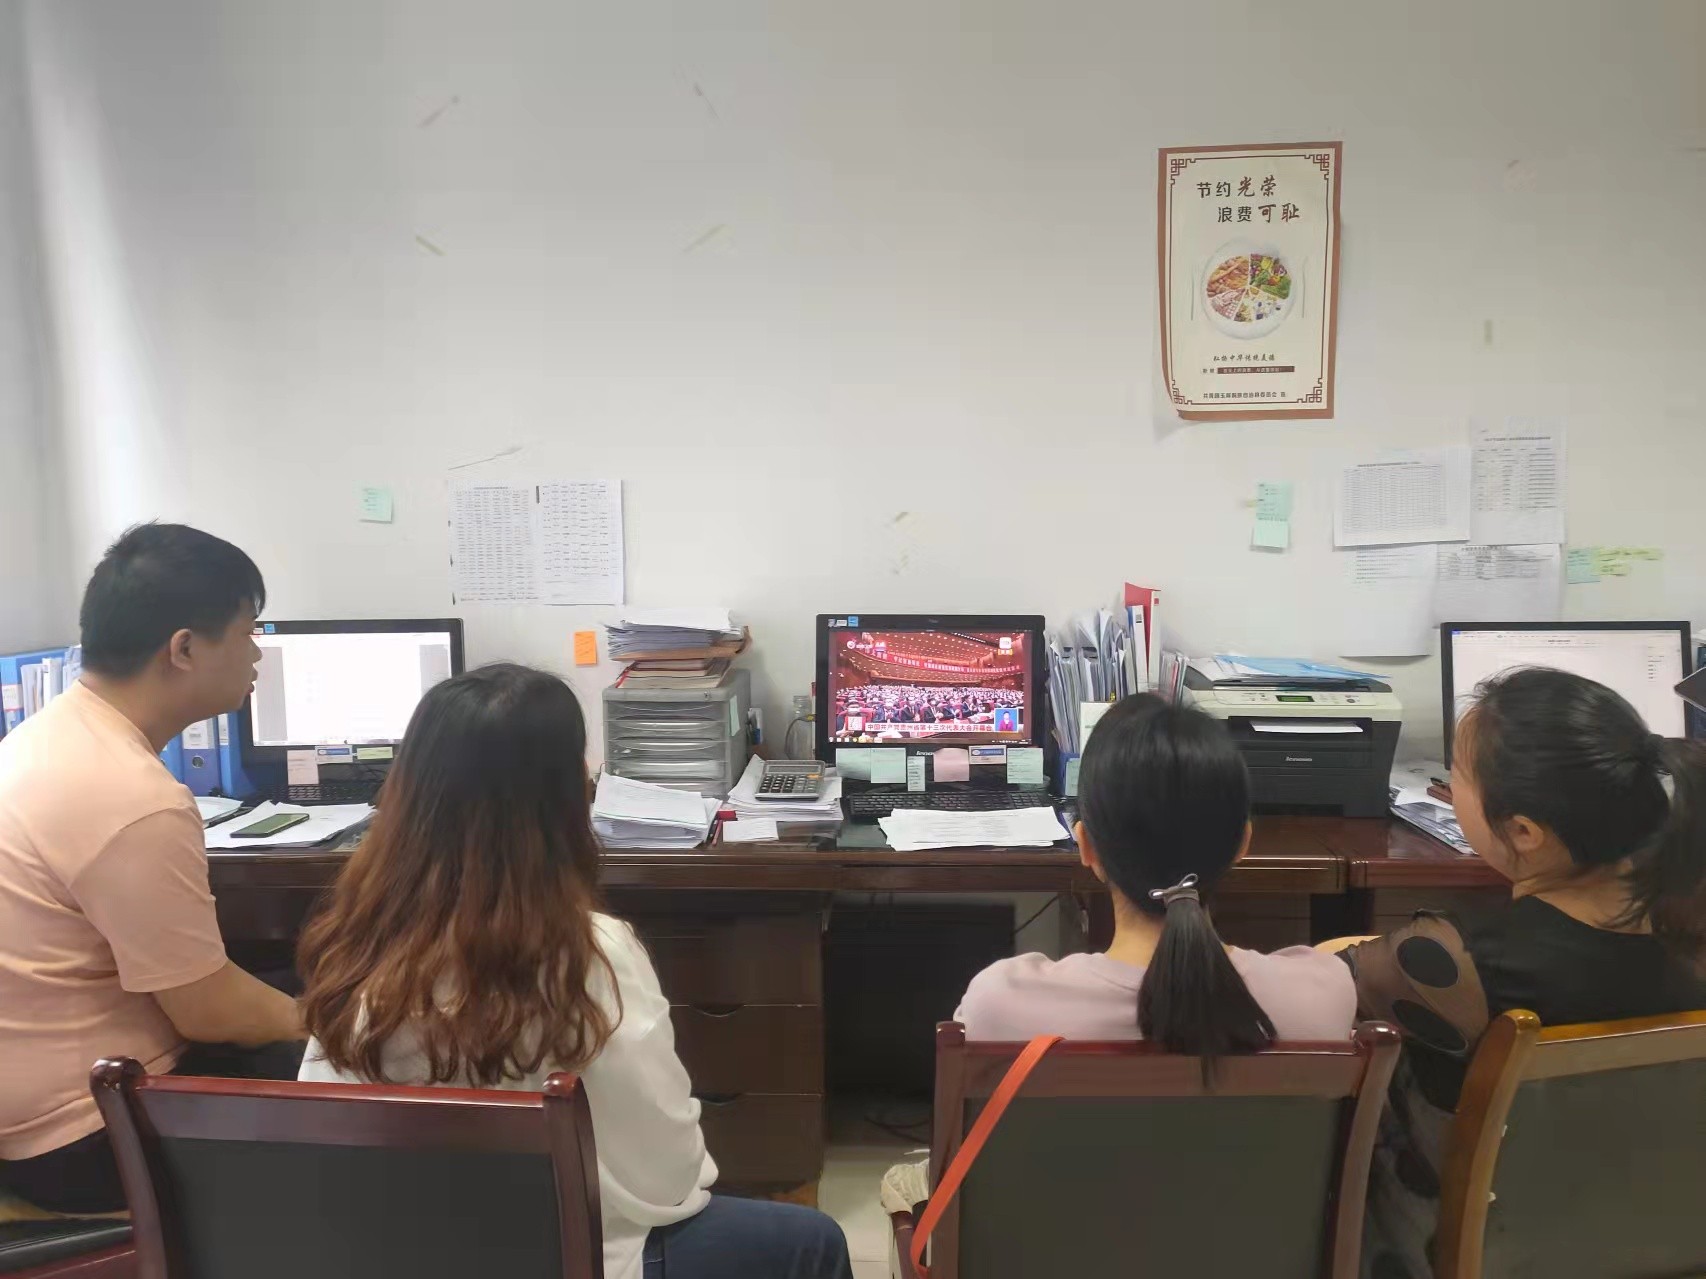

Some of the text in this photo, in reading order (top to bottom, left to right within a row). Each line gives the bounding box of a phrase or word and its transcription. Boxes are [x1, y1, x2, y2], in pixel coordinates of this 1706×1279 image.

[1197, 175, 1277, 198] 节约光荣
[1218, 203, 1300, 223] 浪费可耻
